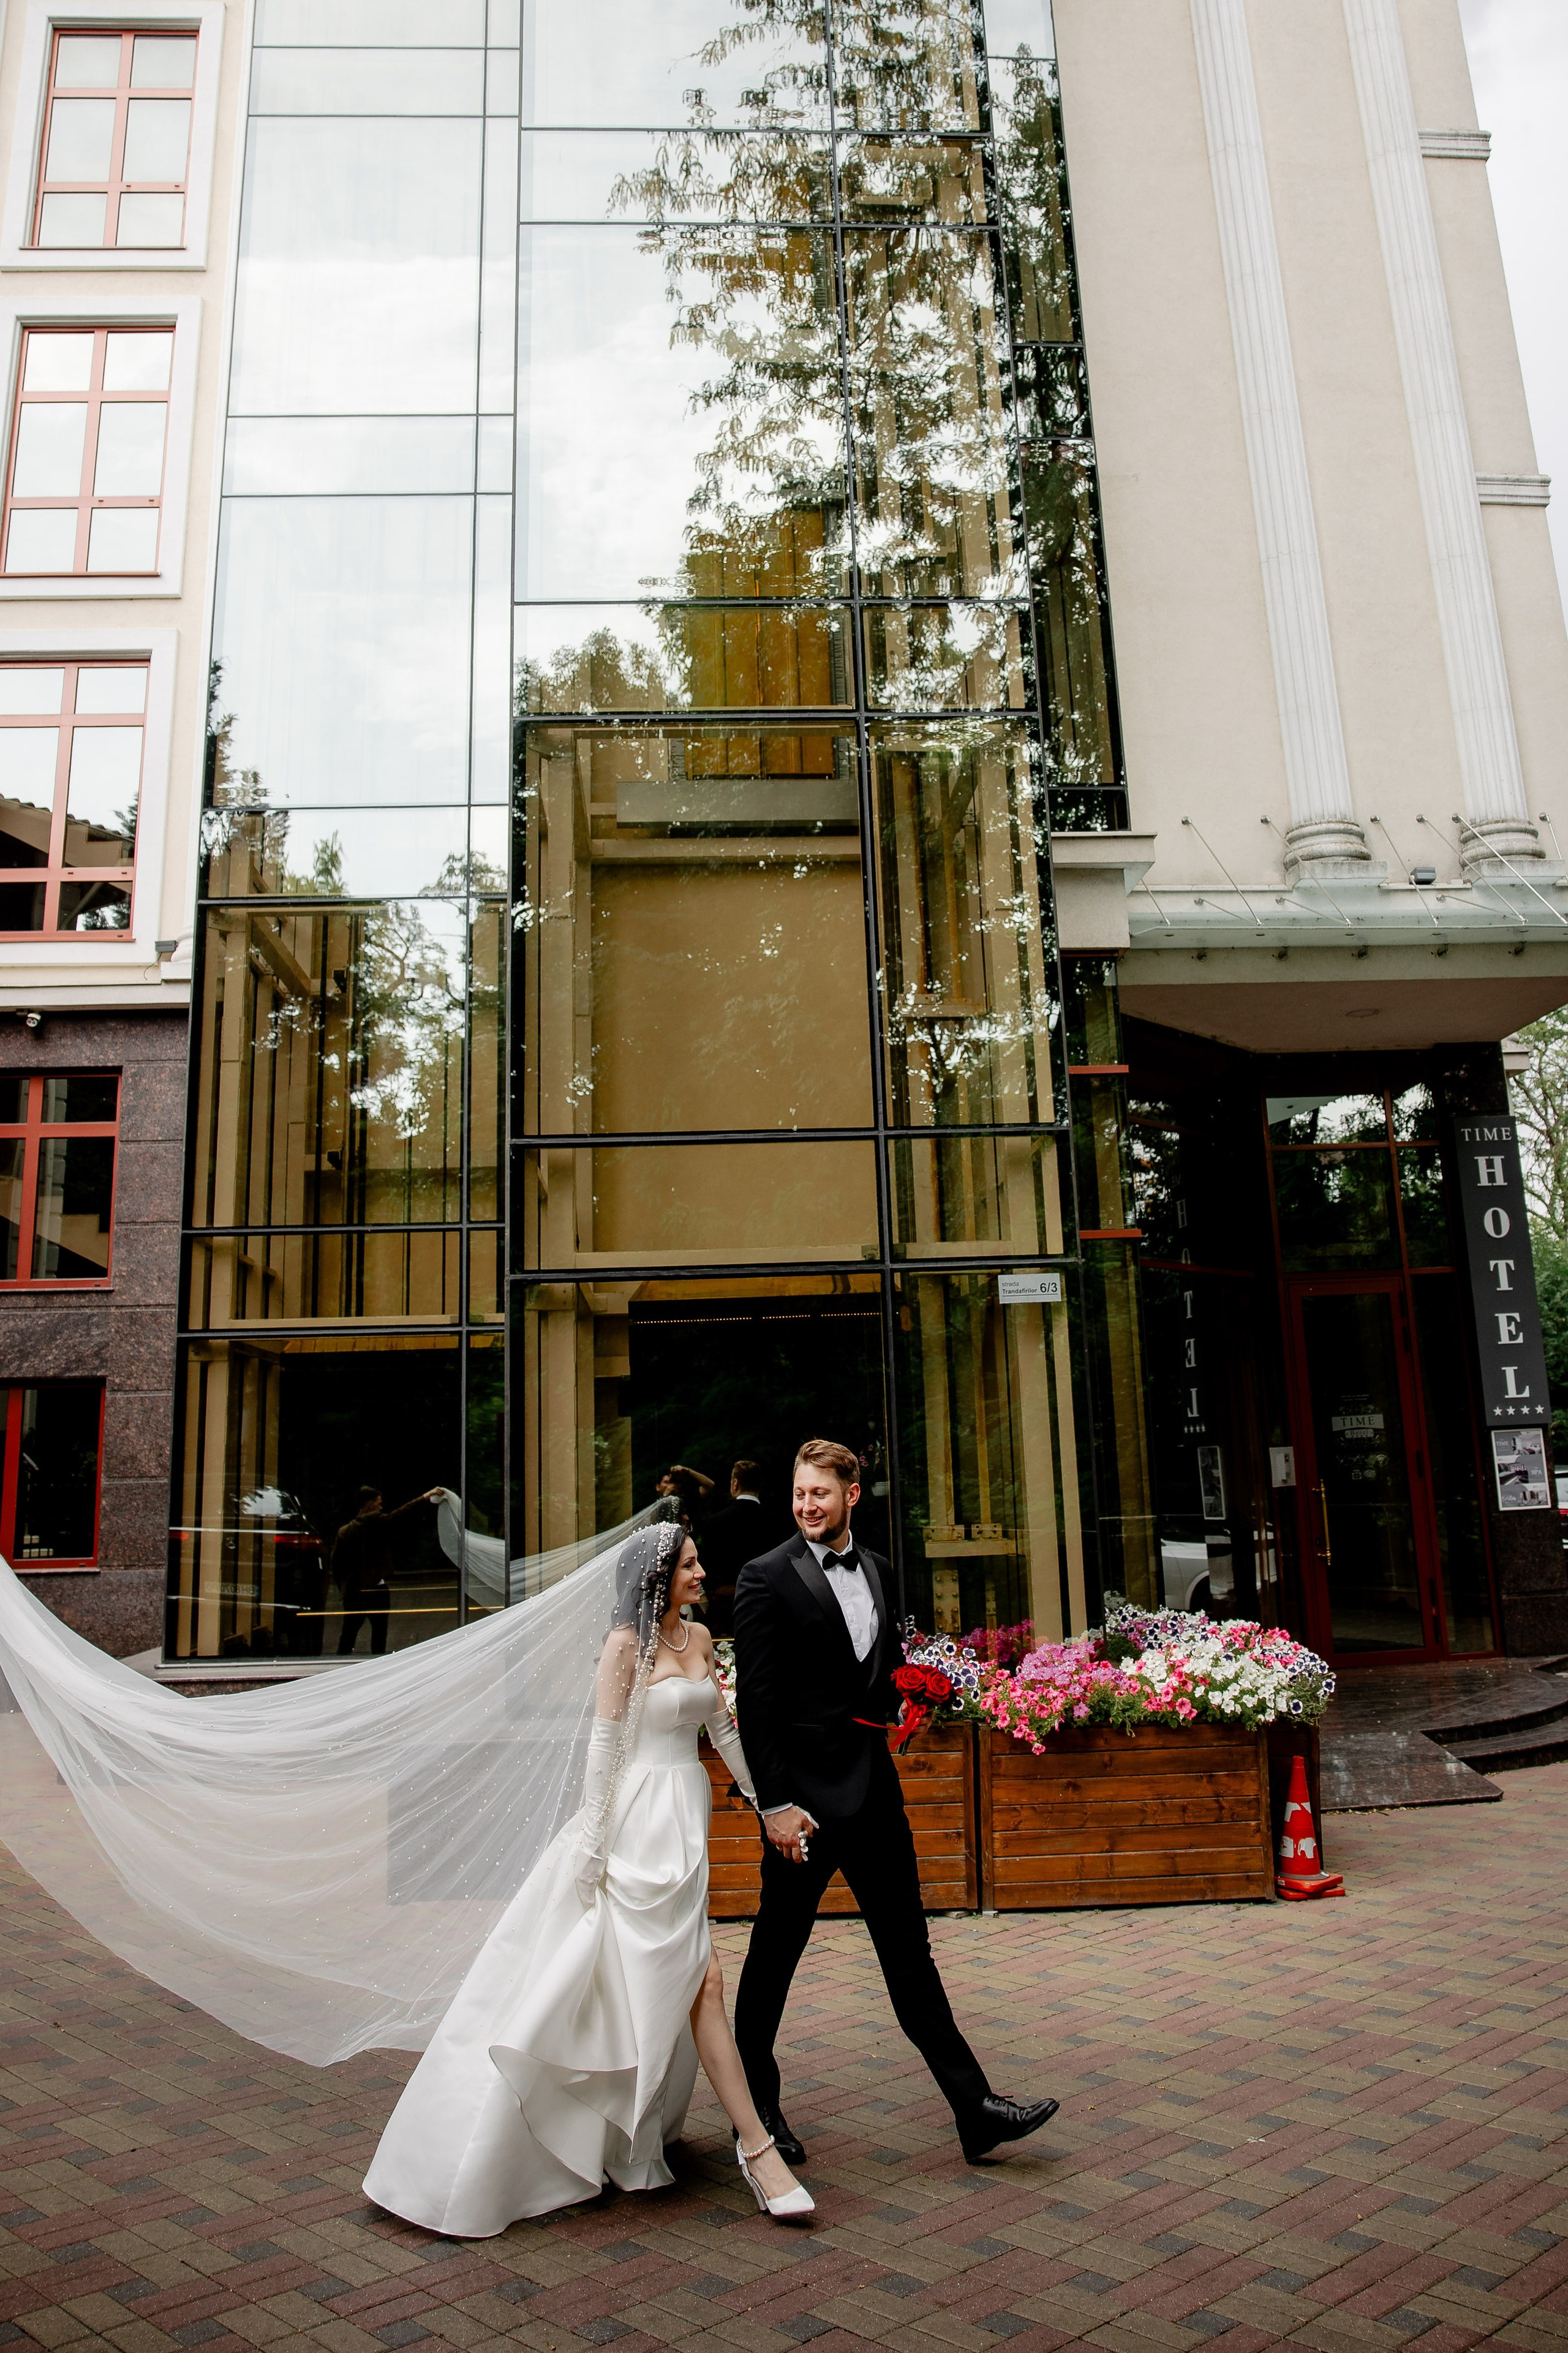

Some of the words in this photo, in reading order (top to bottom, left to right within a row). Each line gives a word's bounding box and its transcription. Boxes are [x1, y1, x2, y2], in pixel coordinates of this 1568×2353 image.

[1461, 1127, 1512, 1141] TIME
[1474, 1155, 1530, 1399] HOTEL
[1039, 1282, 1058, 1293] 6/3
[1340, 1416, 1375, 1427] TIME
